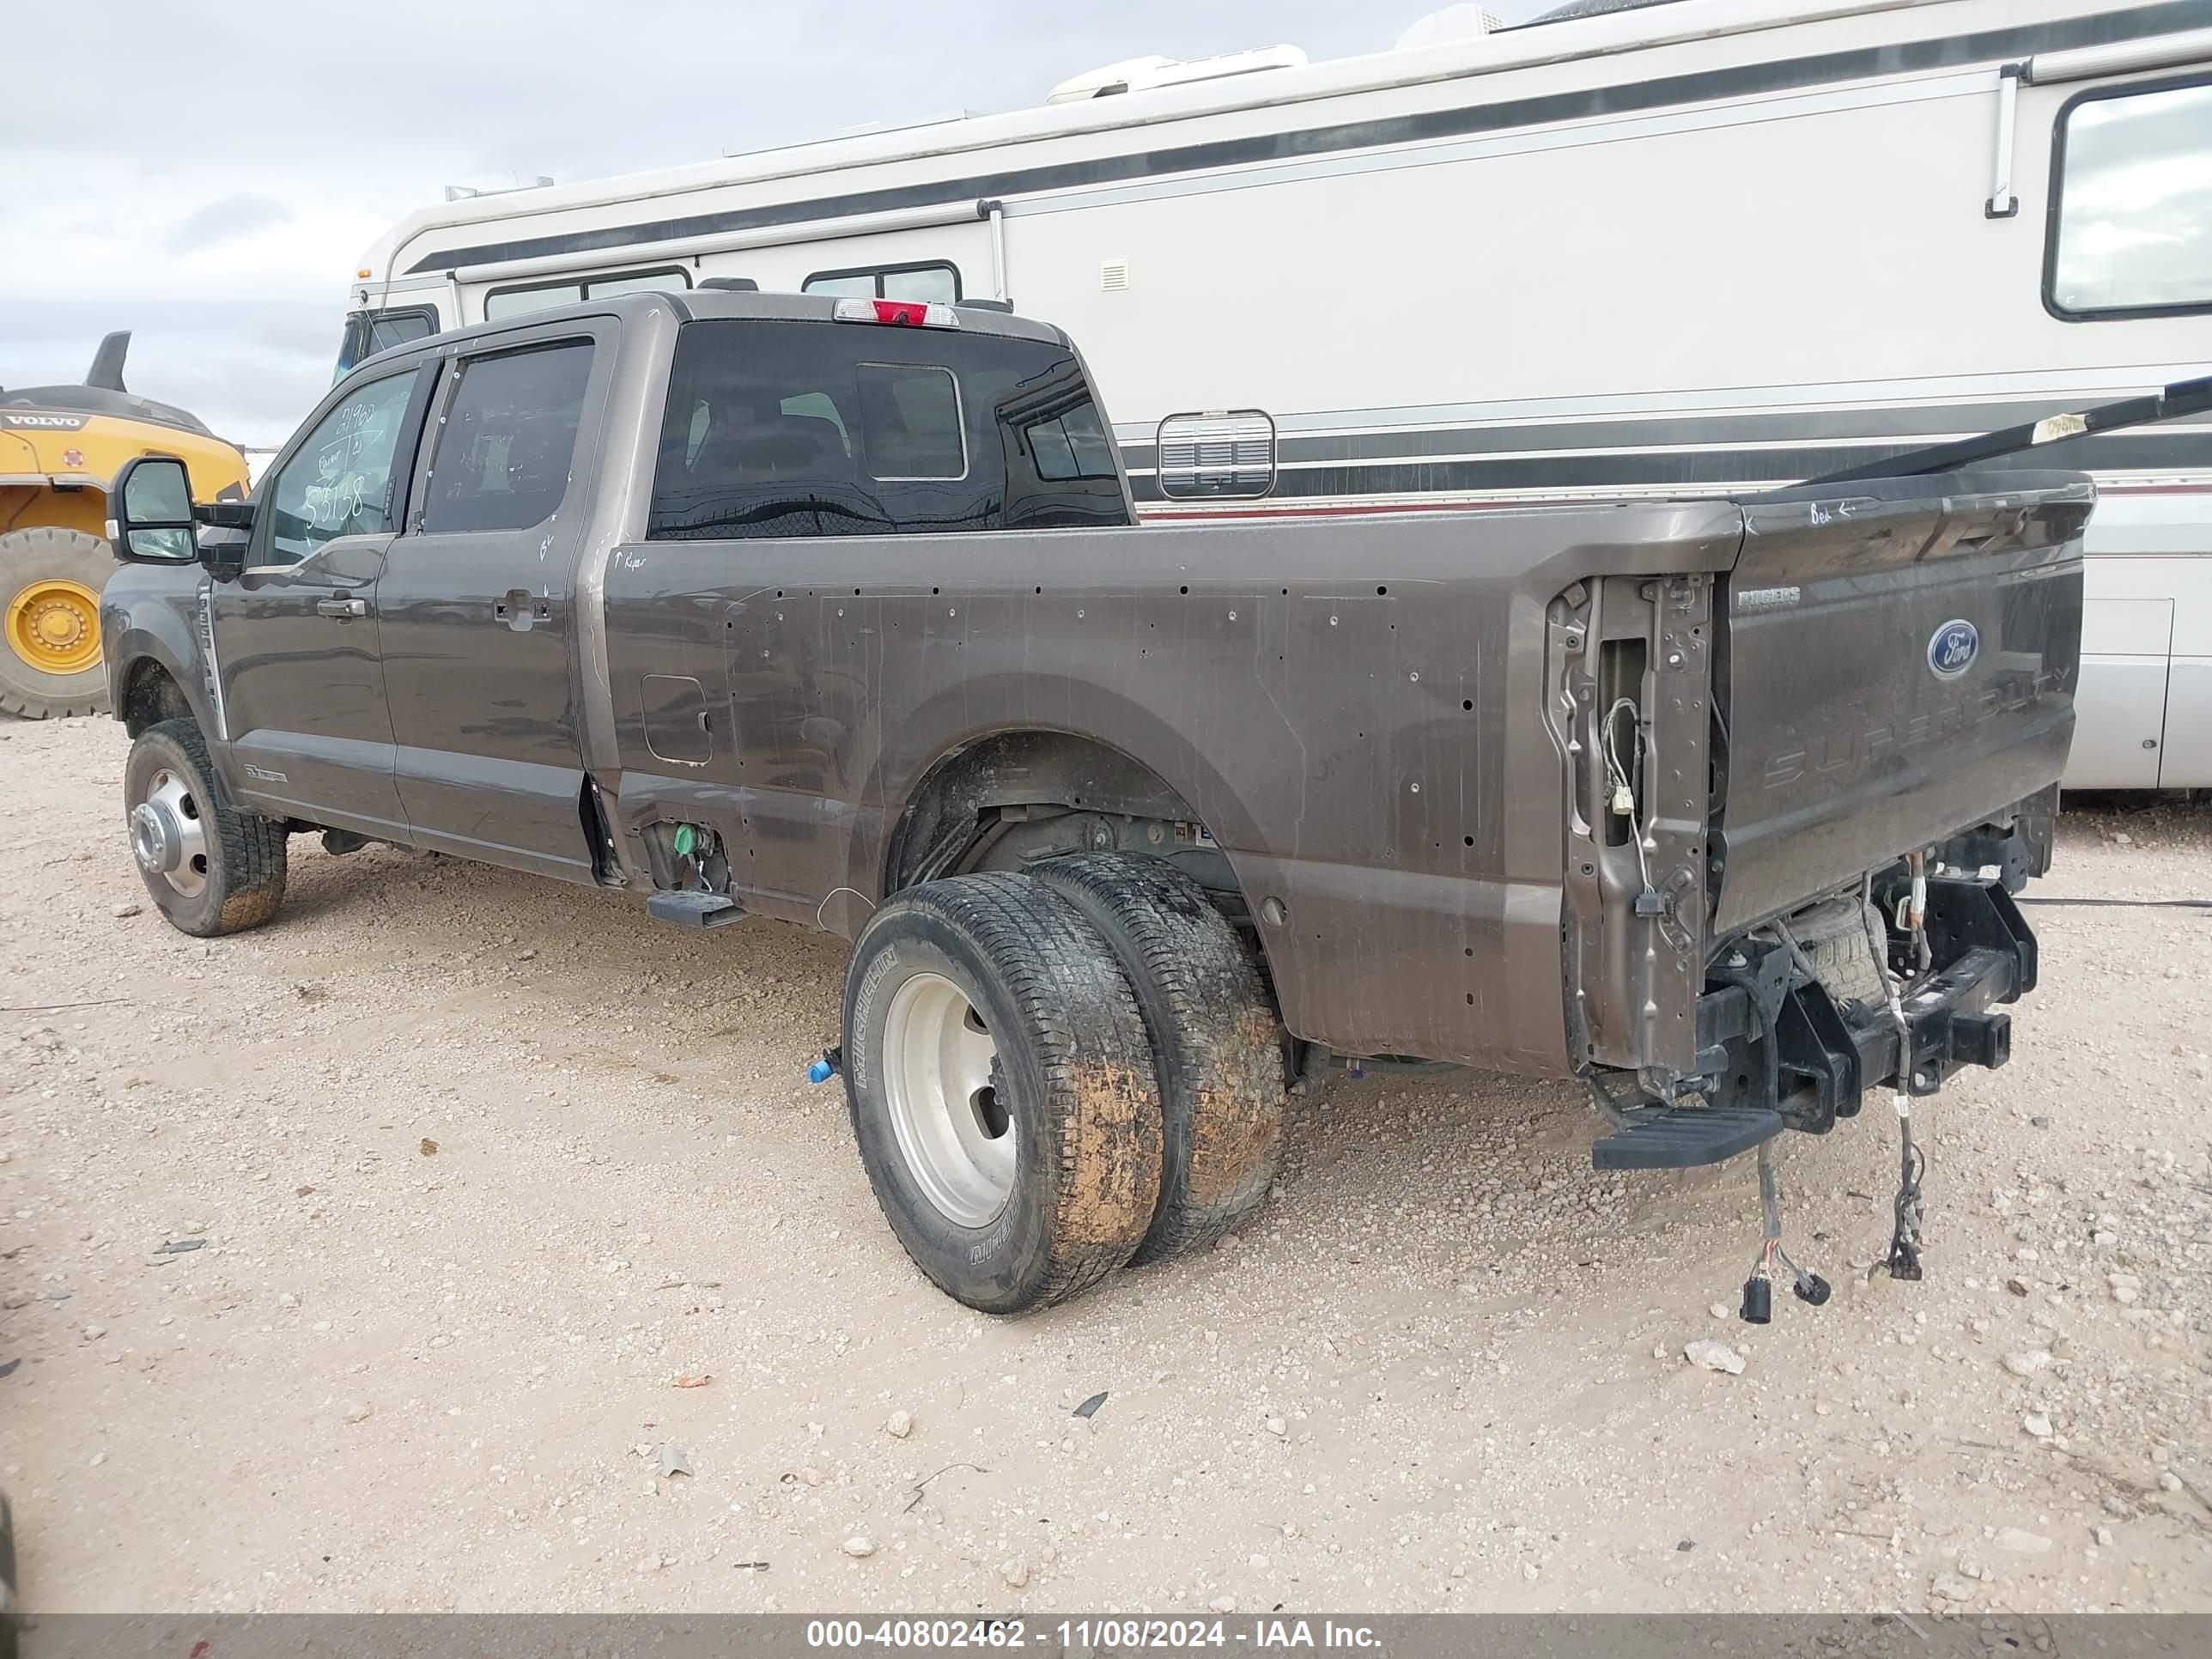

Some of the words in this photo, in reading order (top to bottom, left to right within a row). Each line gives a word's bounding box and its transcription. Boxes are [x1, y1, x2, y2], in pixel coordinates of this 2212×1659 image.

[5, 416, 81, 426] VOLVO
[1810, 502, 1832, 525] Bed
[1944, 632, 1972, 665] Ford
[853, 947, 898, 1089] MICHELIN
